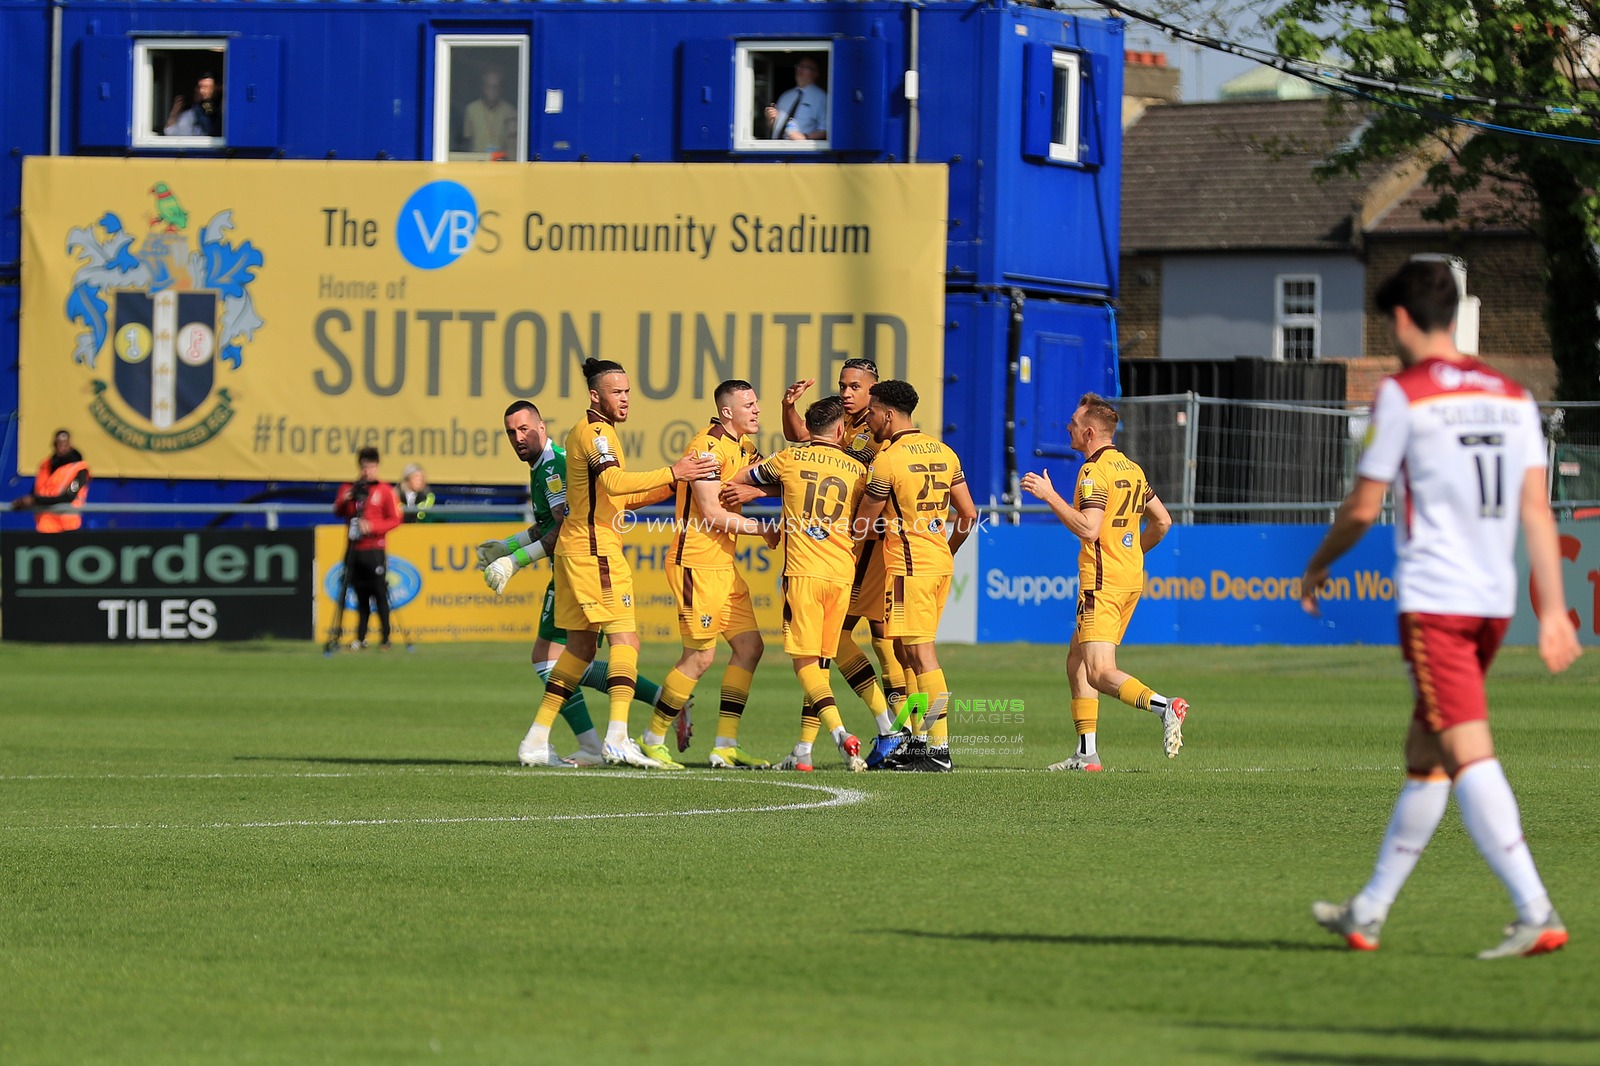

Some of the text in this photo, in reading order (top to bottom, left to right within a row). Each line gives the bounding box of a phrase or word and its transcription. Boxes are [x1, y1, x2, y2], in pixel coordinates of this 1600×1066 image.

[322, 207, 871, 259] The VBS Community Stadium
[318, 274, 408, 300] Home of
[312, 307, 909, 402] SUTTON UNITED
[253, 414, 503, 457] #foreveramber
[908, 442, 942, 455] WILSON
[793, 450, 867, 479] BEAUTYMAN
[908, 463, 950, 512] 25
[1458, 433, 1505, 519] 11
[799, 470, 848, 525] 10
[1112, 479, 1146, 527] 24
[14, 533, 299, 585] norden
[97, 598, 218, 640] TILES
